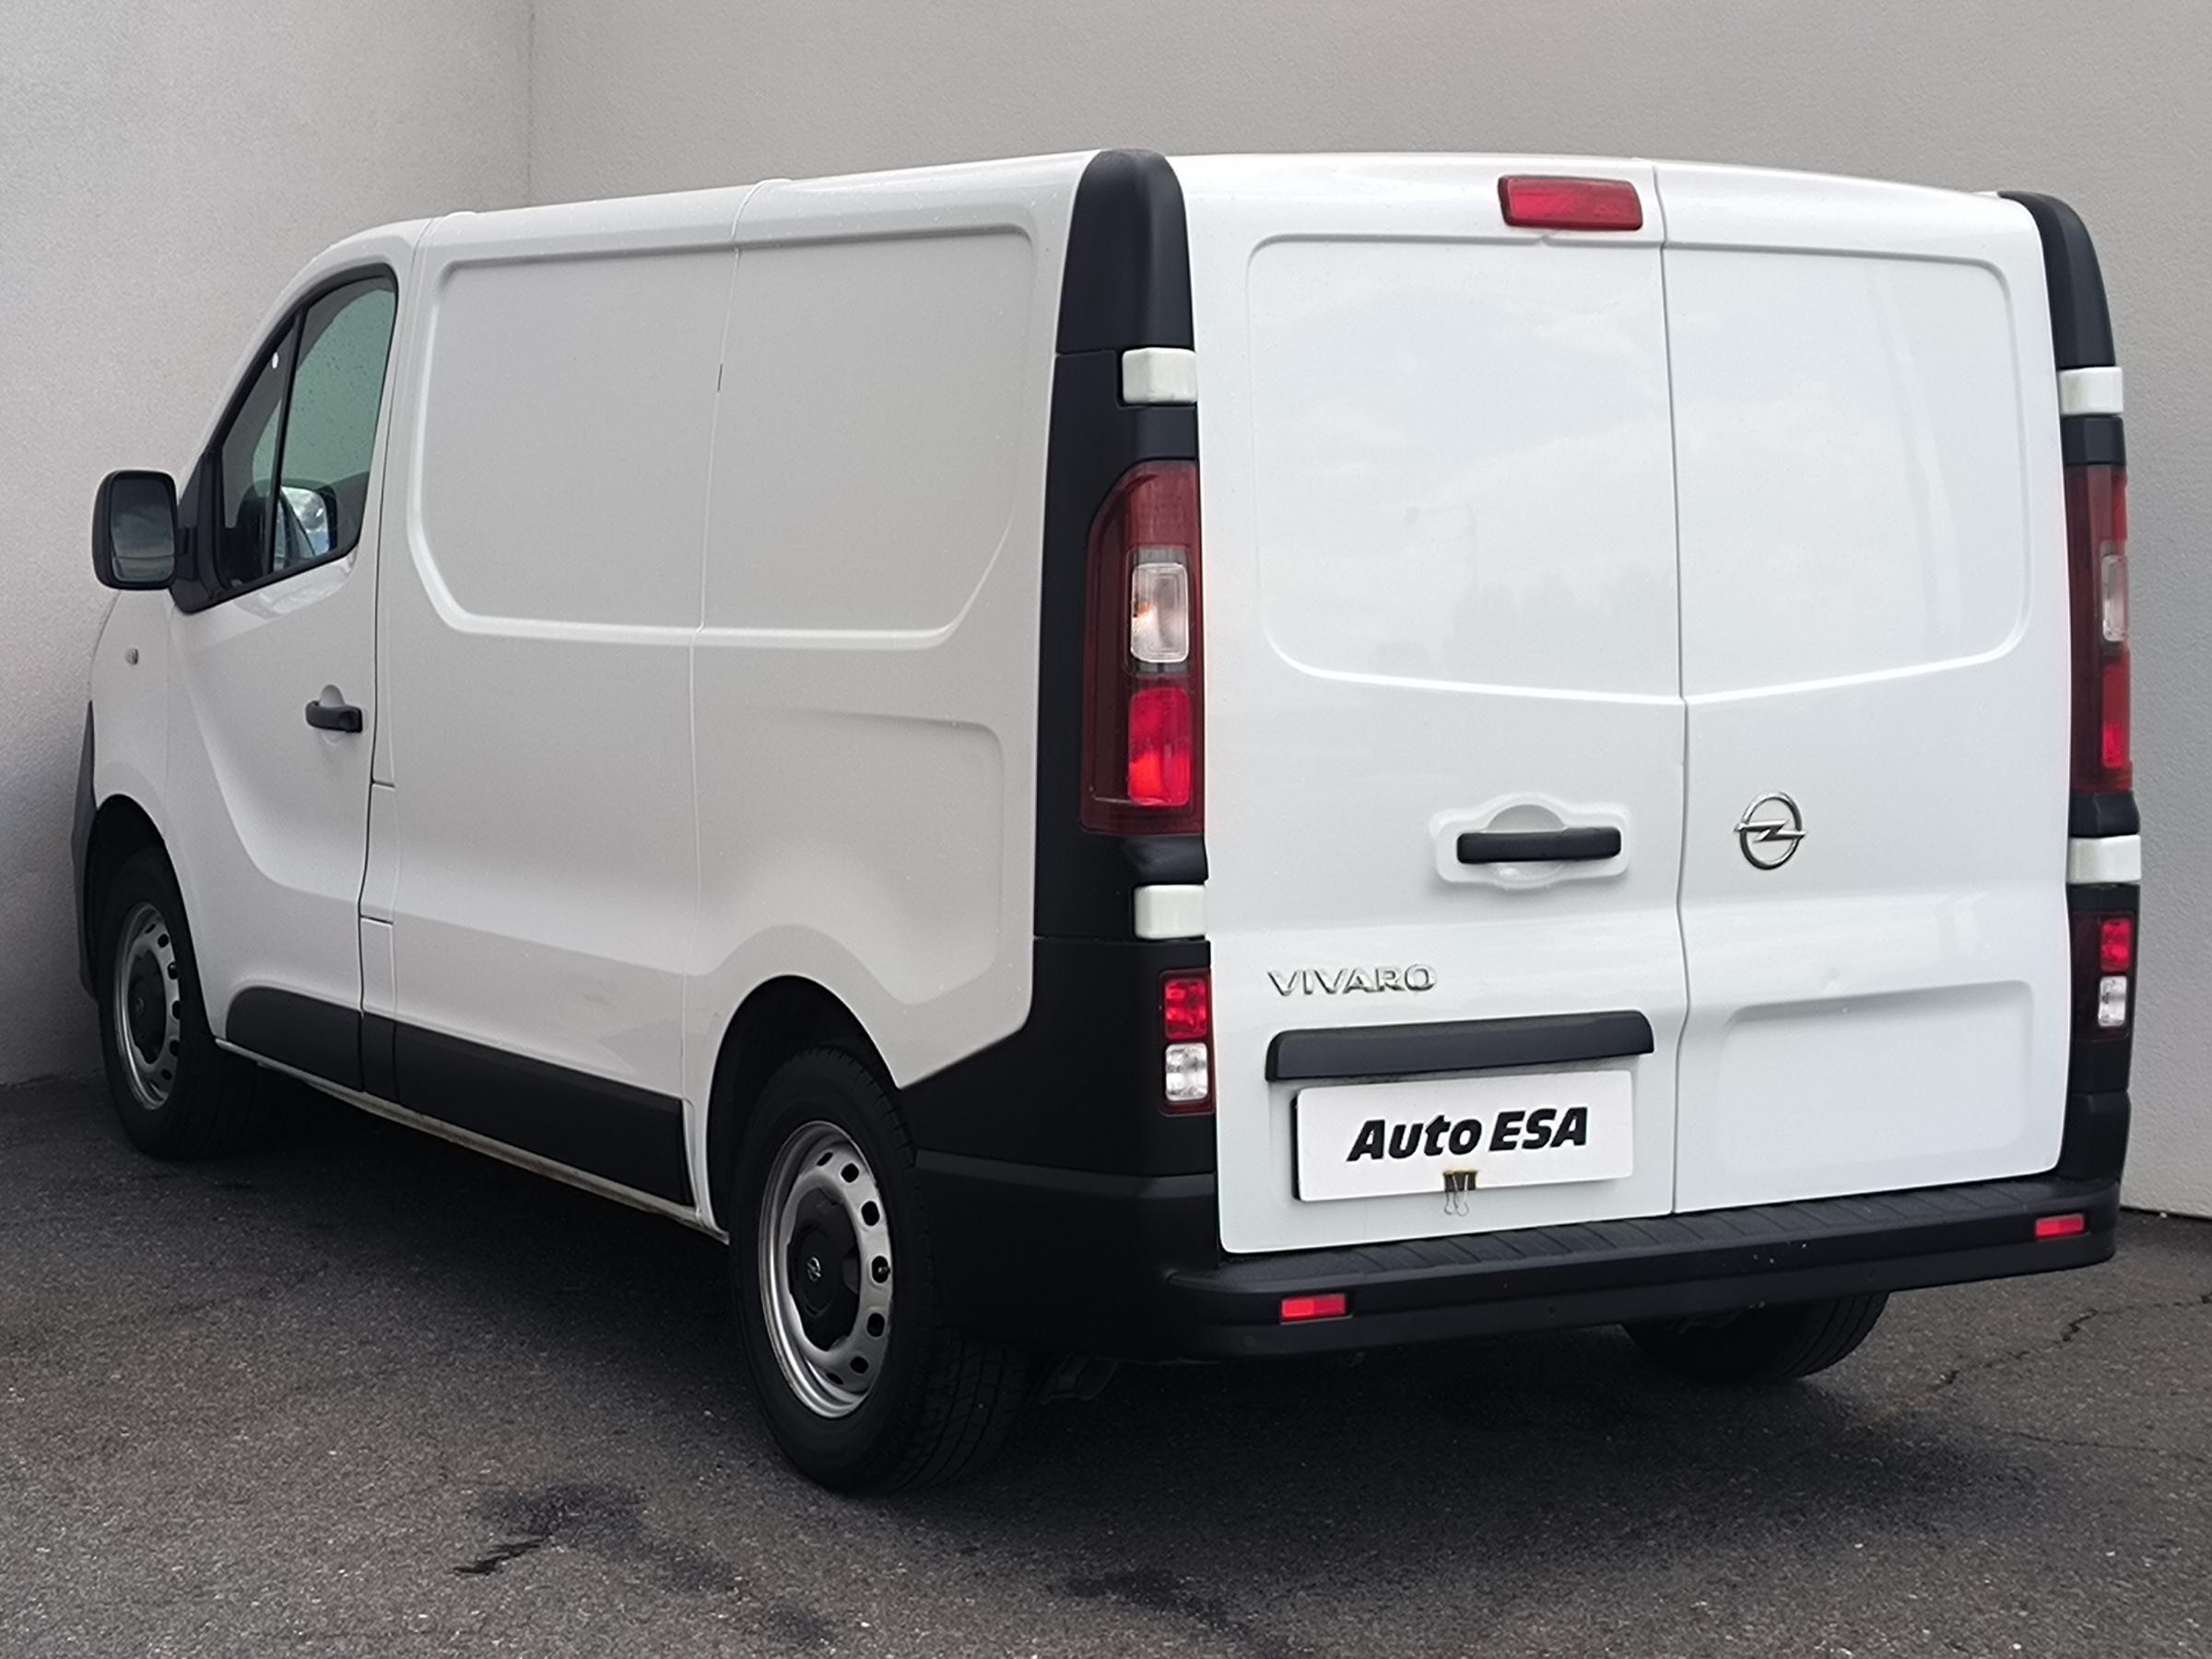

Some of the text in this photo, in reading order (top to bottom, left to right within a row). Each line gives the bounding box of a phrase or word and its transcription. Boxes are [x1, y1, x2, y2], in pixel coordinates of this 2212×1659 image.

[1267, 964, 1437, 995] VIVARO
[1347, 1107, 1588, 1162] Auto ESA
